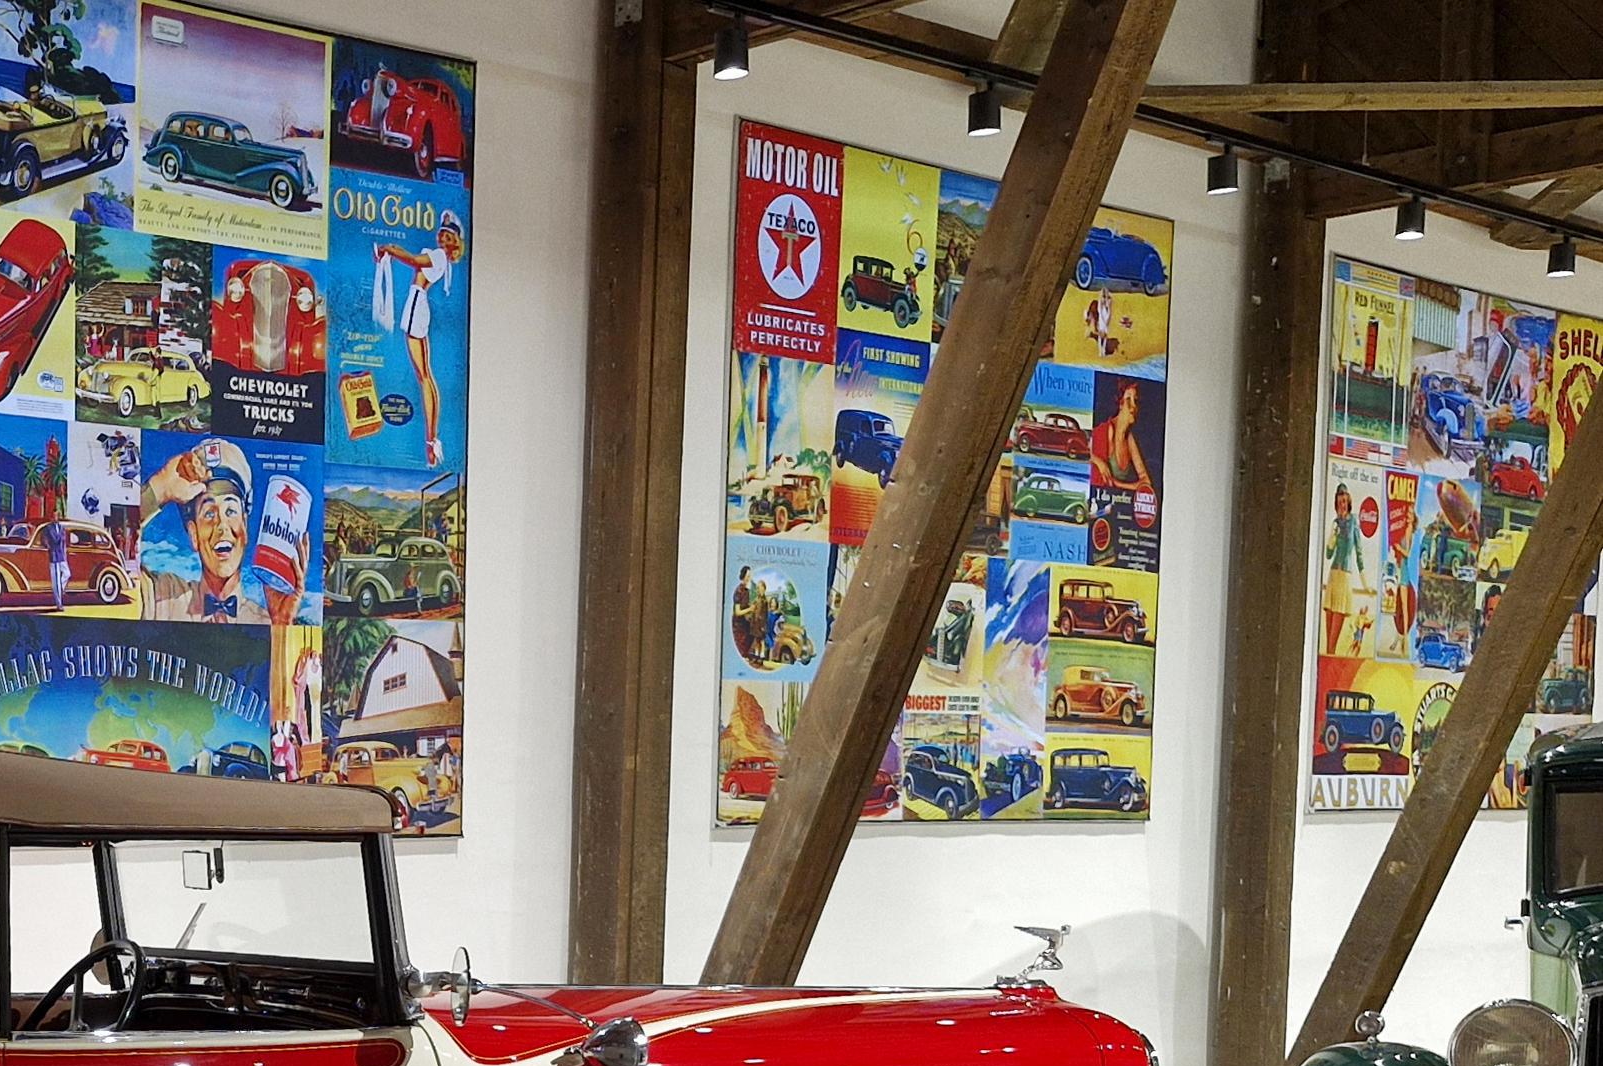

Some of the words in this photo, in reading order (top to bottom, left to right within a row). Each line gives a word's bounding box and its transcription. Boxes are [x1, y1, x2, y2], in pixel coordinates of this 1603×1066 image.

[746, 137, 808, 189] MOTOR
[812, 153, 839, 197] OIL
[138, 199, 154, 212] The
[155, 202, 183, 220] Royal
[183, 206, 212, 226] Family
[214, 215, 225, 229] of
[333, 187, 376, 223] Old
[381, 194, 435, 231] Gold
[361, 226, 407, 240] CIGARETTES
[767, 212, 816, 234] TEXACO
[1354, 291, 1368, 308] RED
[1370, 295, 1395, 315] FUNNEL
[747, 312, 825, 337] LUBRICATES
[750, 331, 821, 353] PERFECTLY
[1559, 328, 1603, 366] SHEL
[863, 347, 884, 361] FIRST
[886, 350, 920, 368] SHOWING
[229, 376, 309, 399] CHEVROLET
[1034, 366, 1065, 395] When
[243, 405, 295, 423] TRUCKS
[1388, 474, 1416, 502] CAMEL
[756, 545, 801, 557] CHEVROLET
[1043, 541, 1086, 561] NASH
[64, 645, 139, 679] SHOWS
[148, 650, 187, 689] THE
[196, 663, 270, 727] WORLD!
[905, 695, 947, 711] BIGGEST
